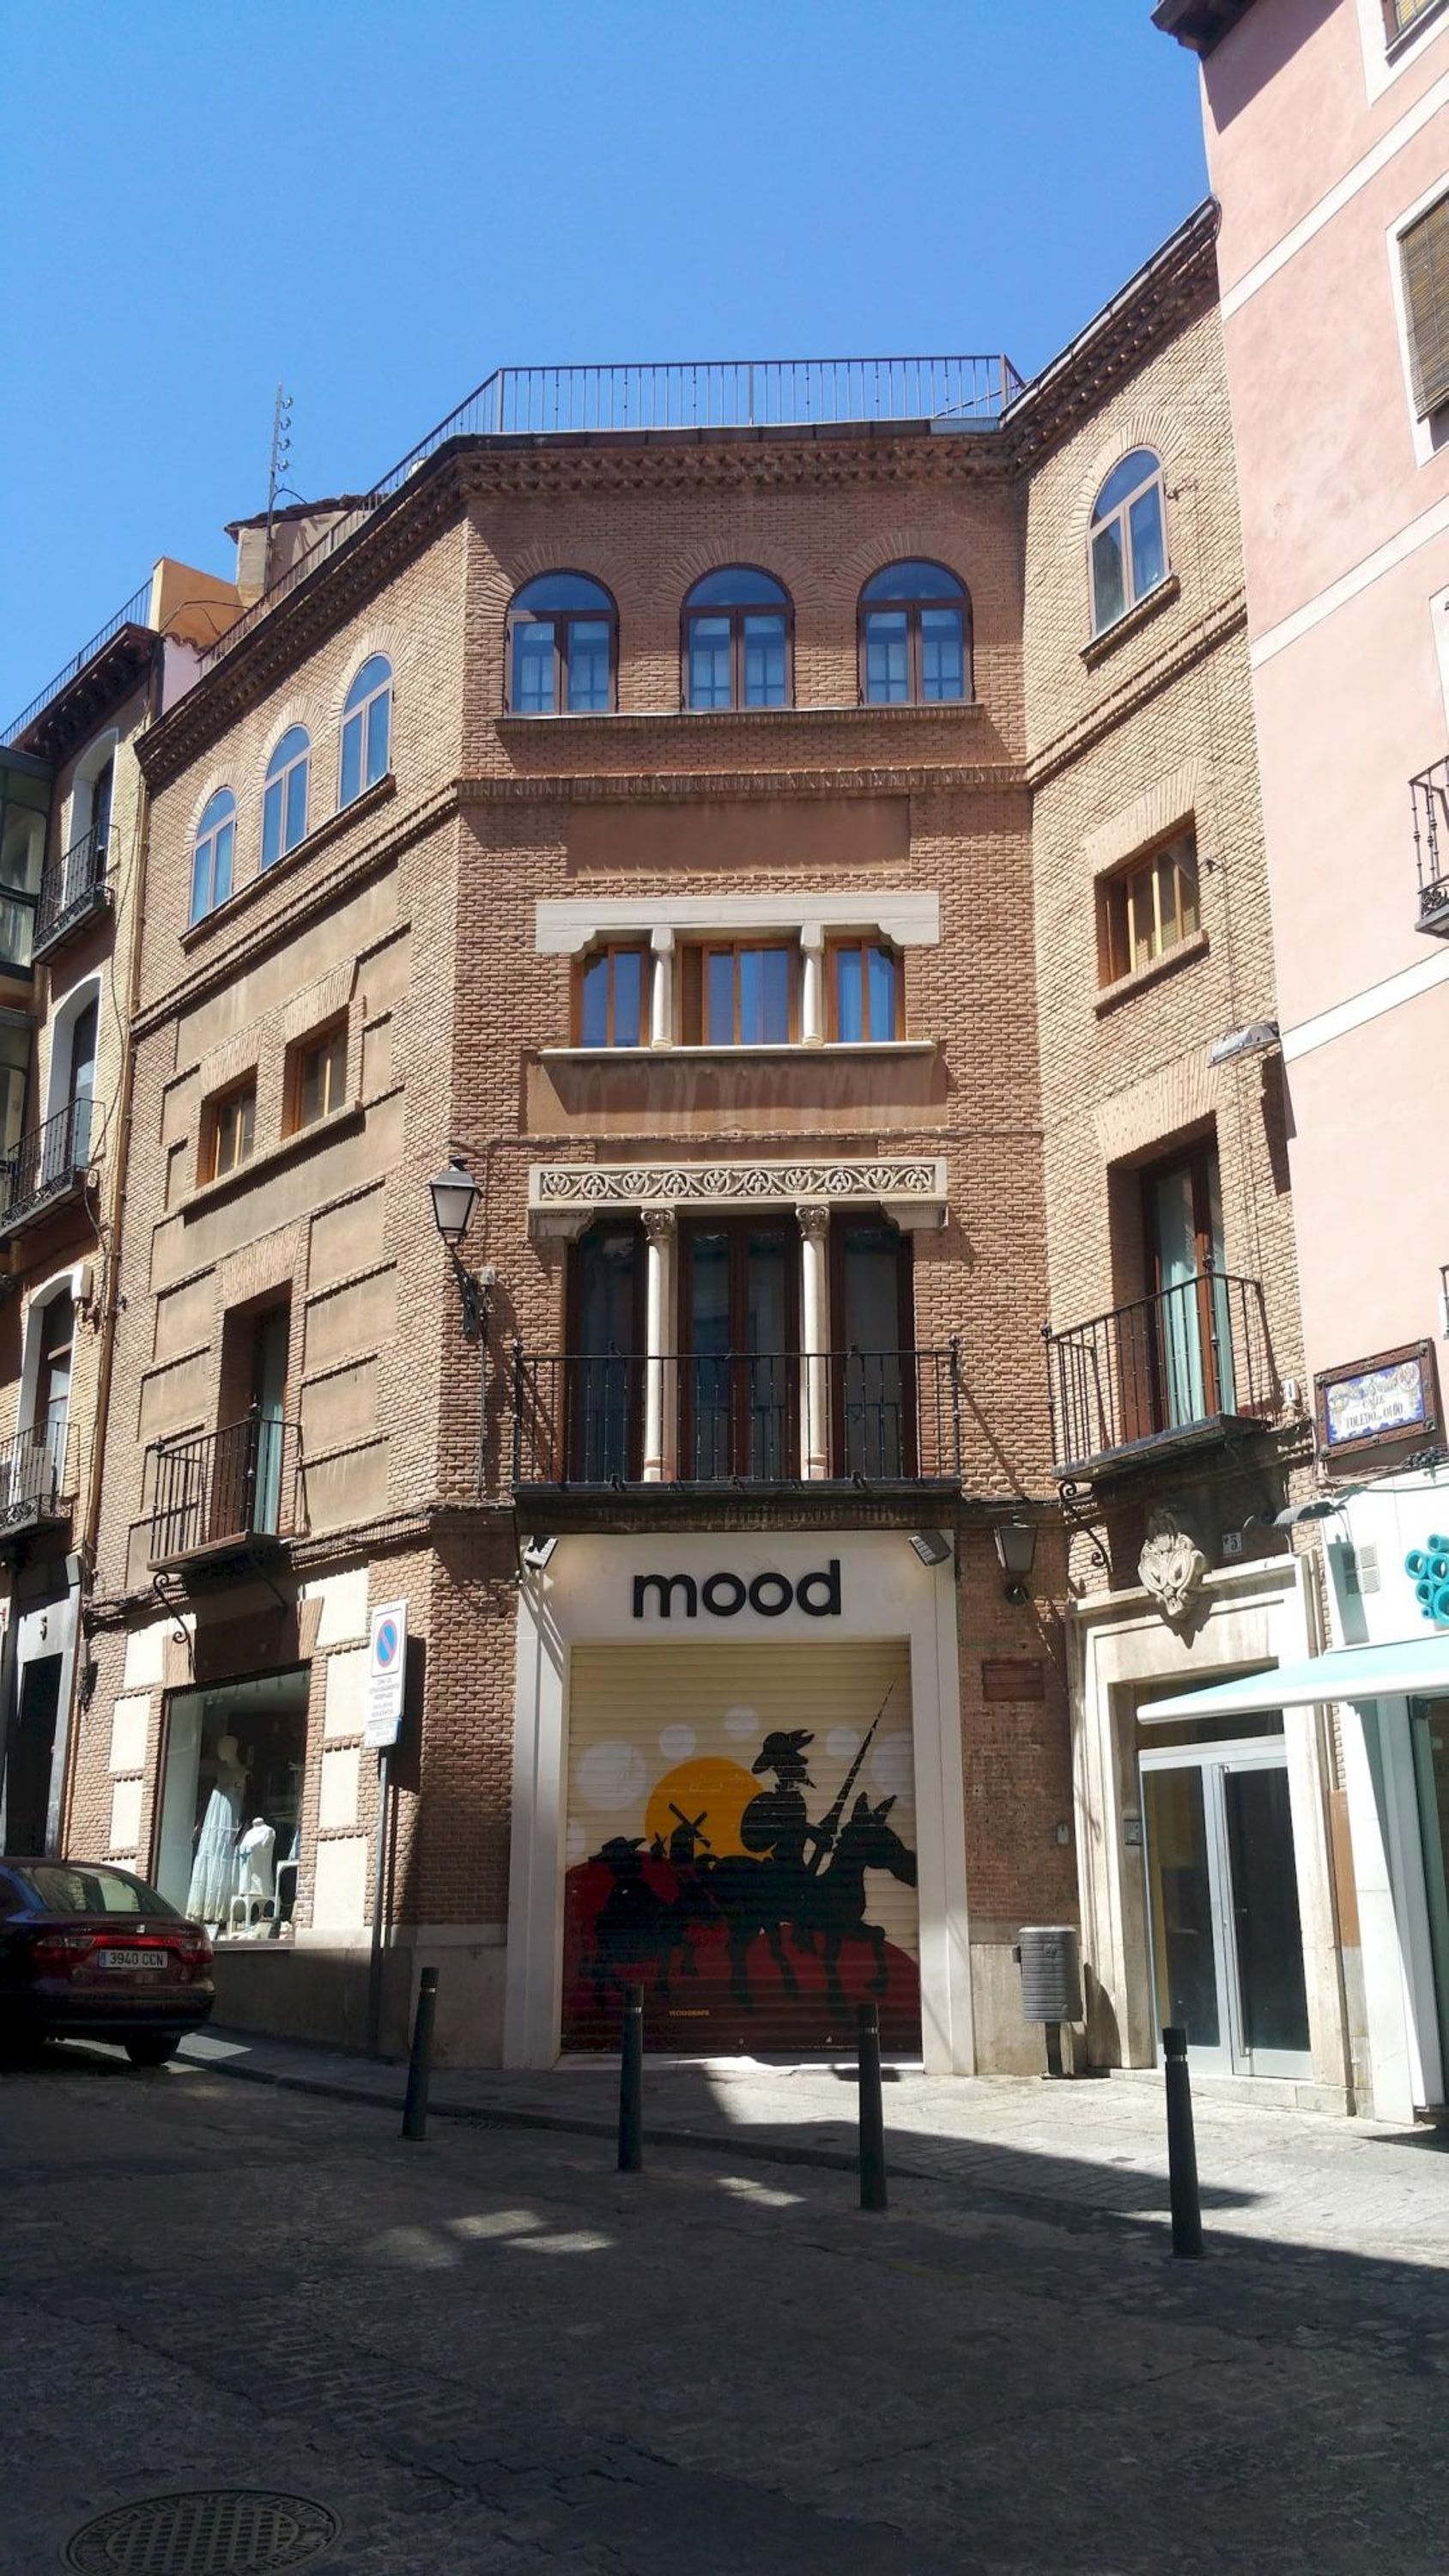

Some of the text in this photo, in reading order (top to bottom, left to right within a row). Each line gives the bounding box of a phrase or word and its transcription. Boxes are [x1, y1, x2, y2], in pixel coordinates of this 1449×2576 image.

[633, 1559, 841, 1618] mood
[110, 1952, 164, 1966] 3940 CCN
